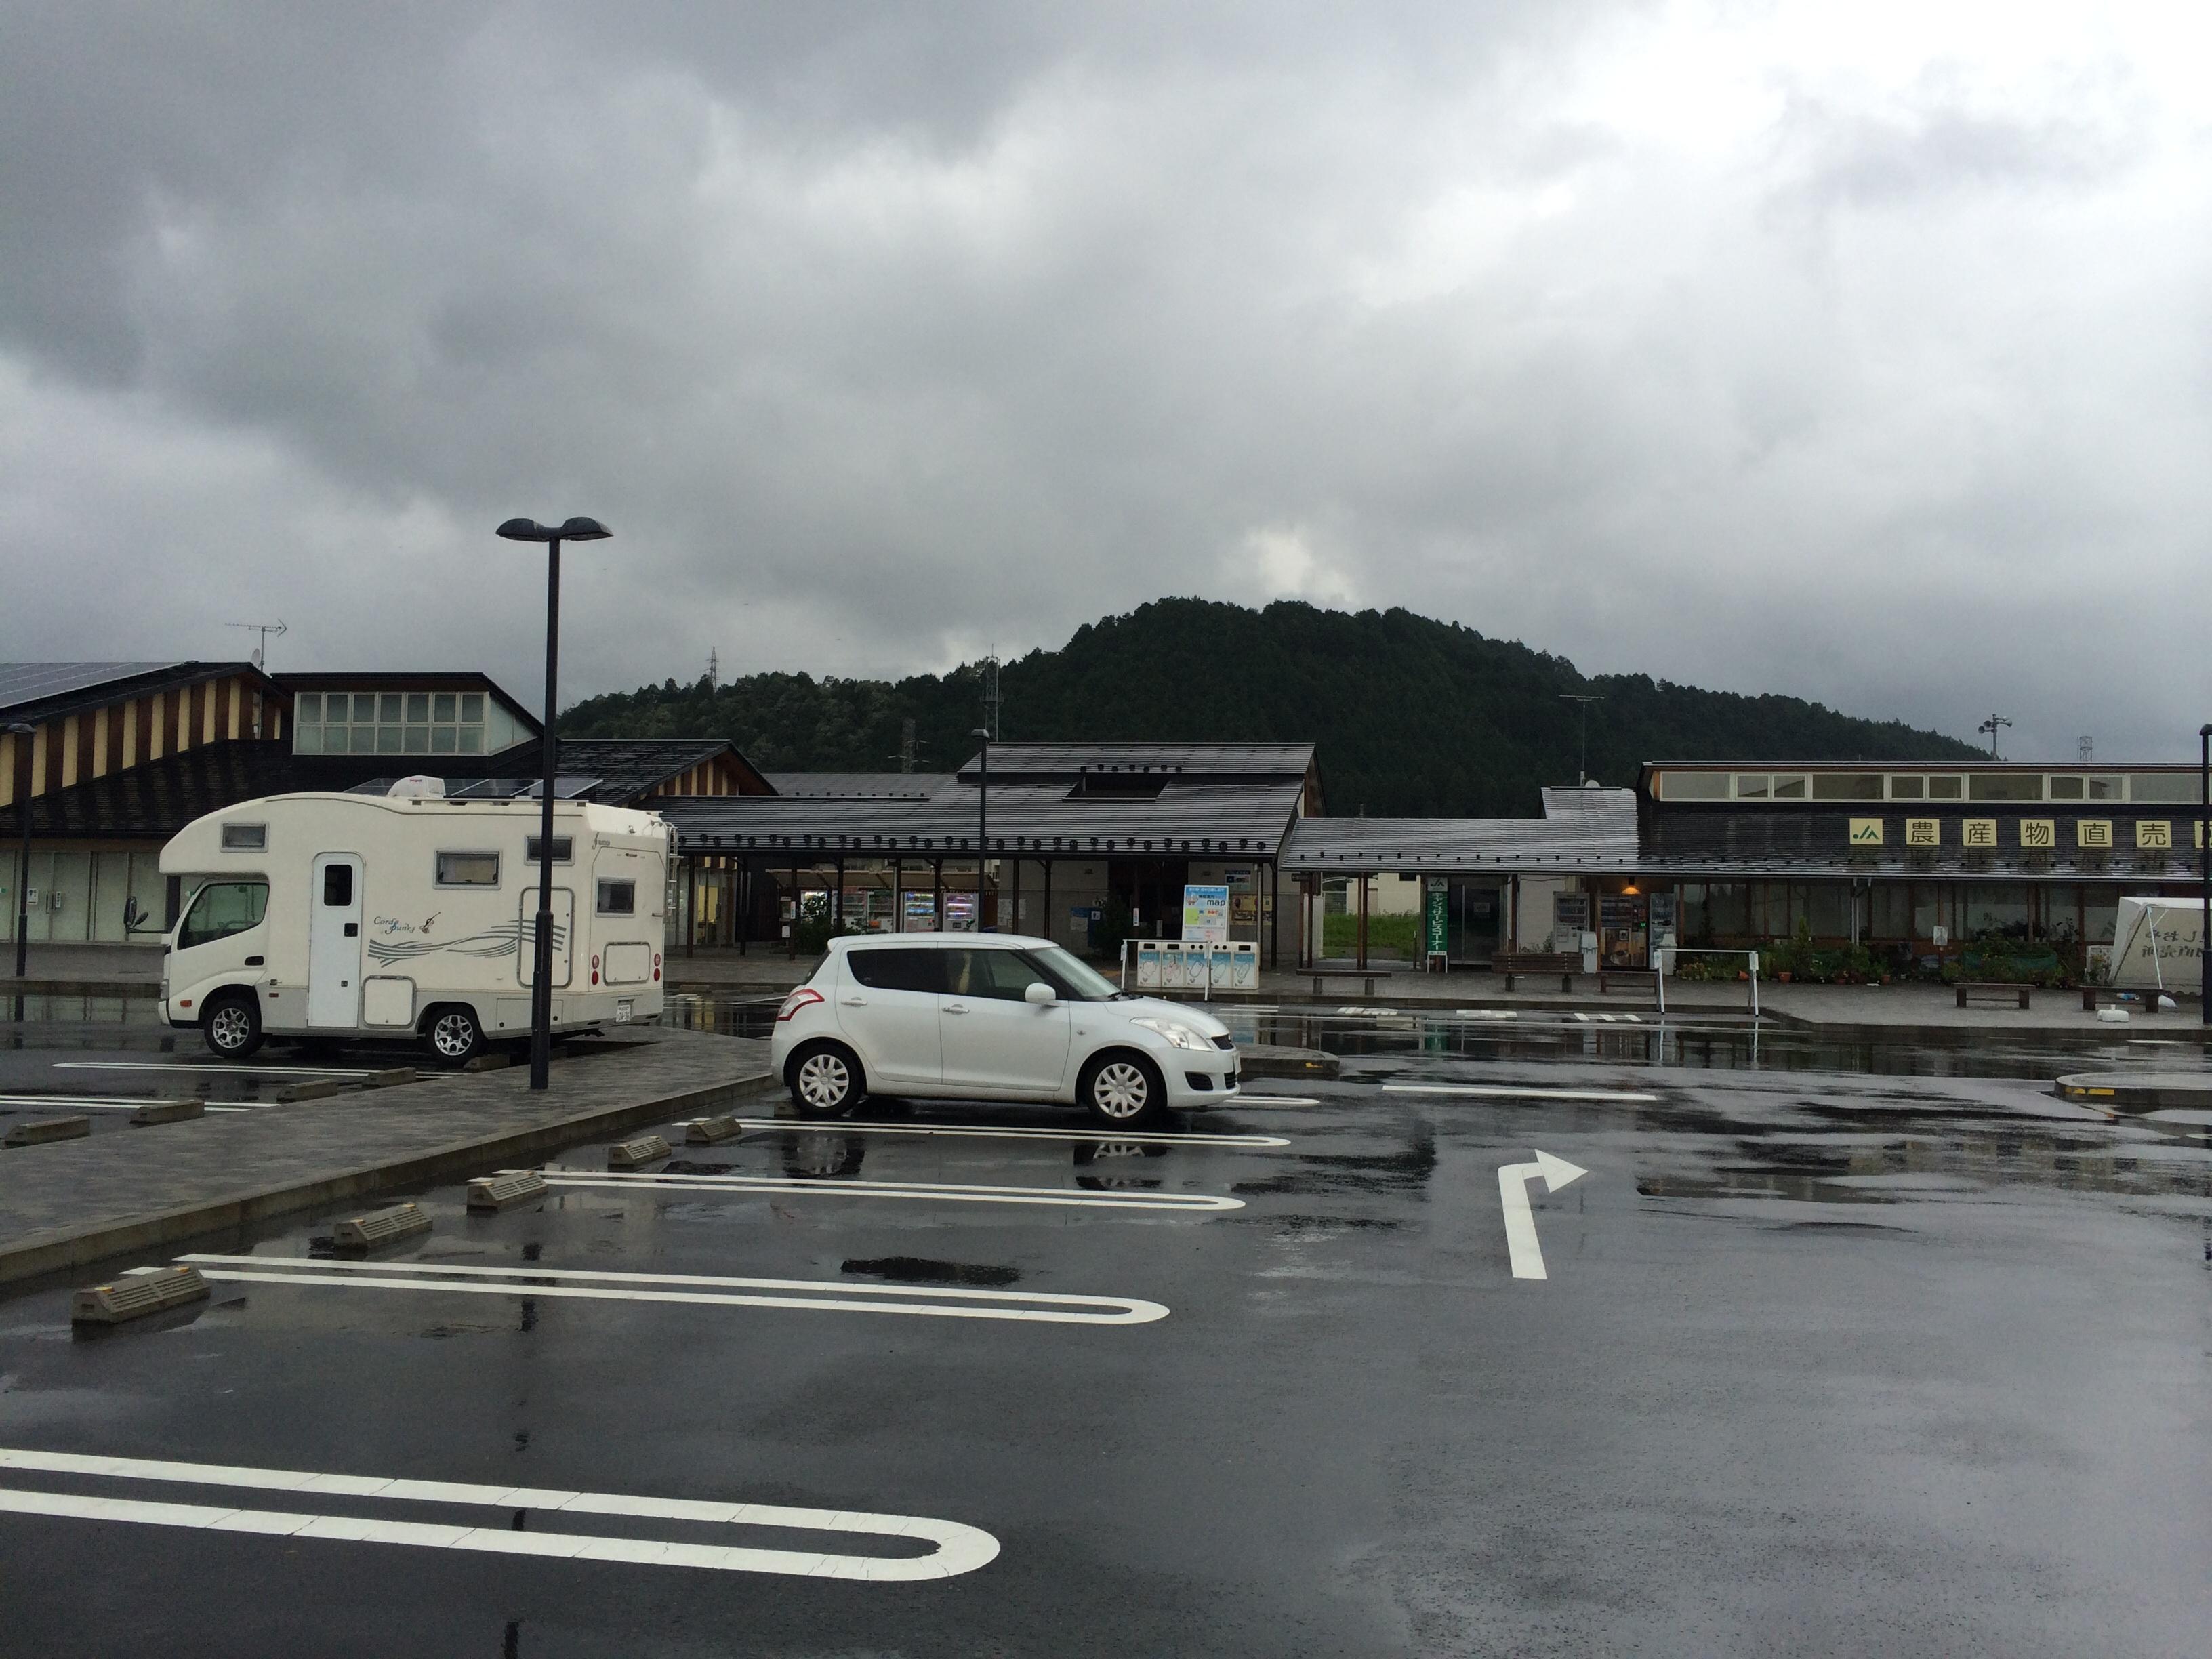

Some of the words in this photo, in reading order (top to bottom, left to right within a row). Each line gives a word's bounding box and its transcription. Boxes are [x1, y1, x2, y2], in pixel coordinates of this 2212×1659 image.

[1910, 821, 2212, 846] 農産物直売
